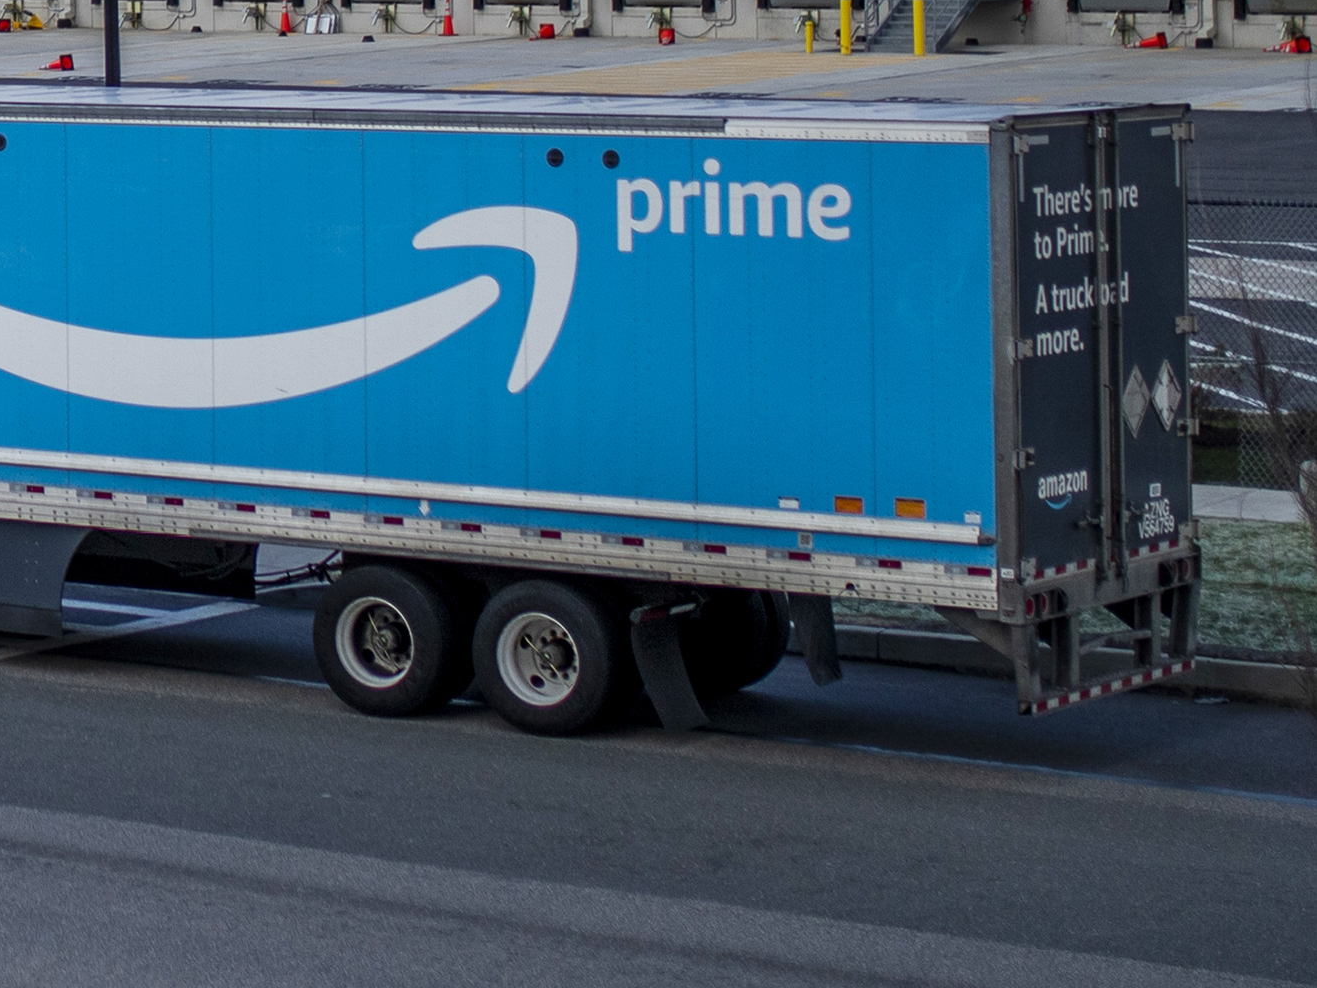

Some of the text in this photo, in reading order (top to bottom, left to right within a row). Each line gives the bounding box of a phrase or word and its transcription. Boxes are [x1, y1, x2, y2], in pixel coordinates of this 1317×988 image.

[616, 157, 852, 252] prime
[1032, 183, 1093, 217] There's
[1033, 232, 1052, 260] to
[1035, 284, 1049, 316] A
[1036, 328, 1085, 357] more.
[1038, 470, 1088, 499] amazon
